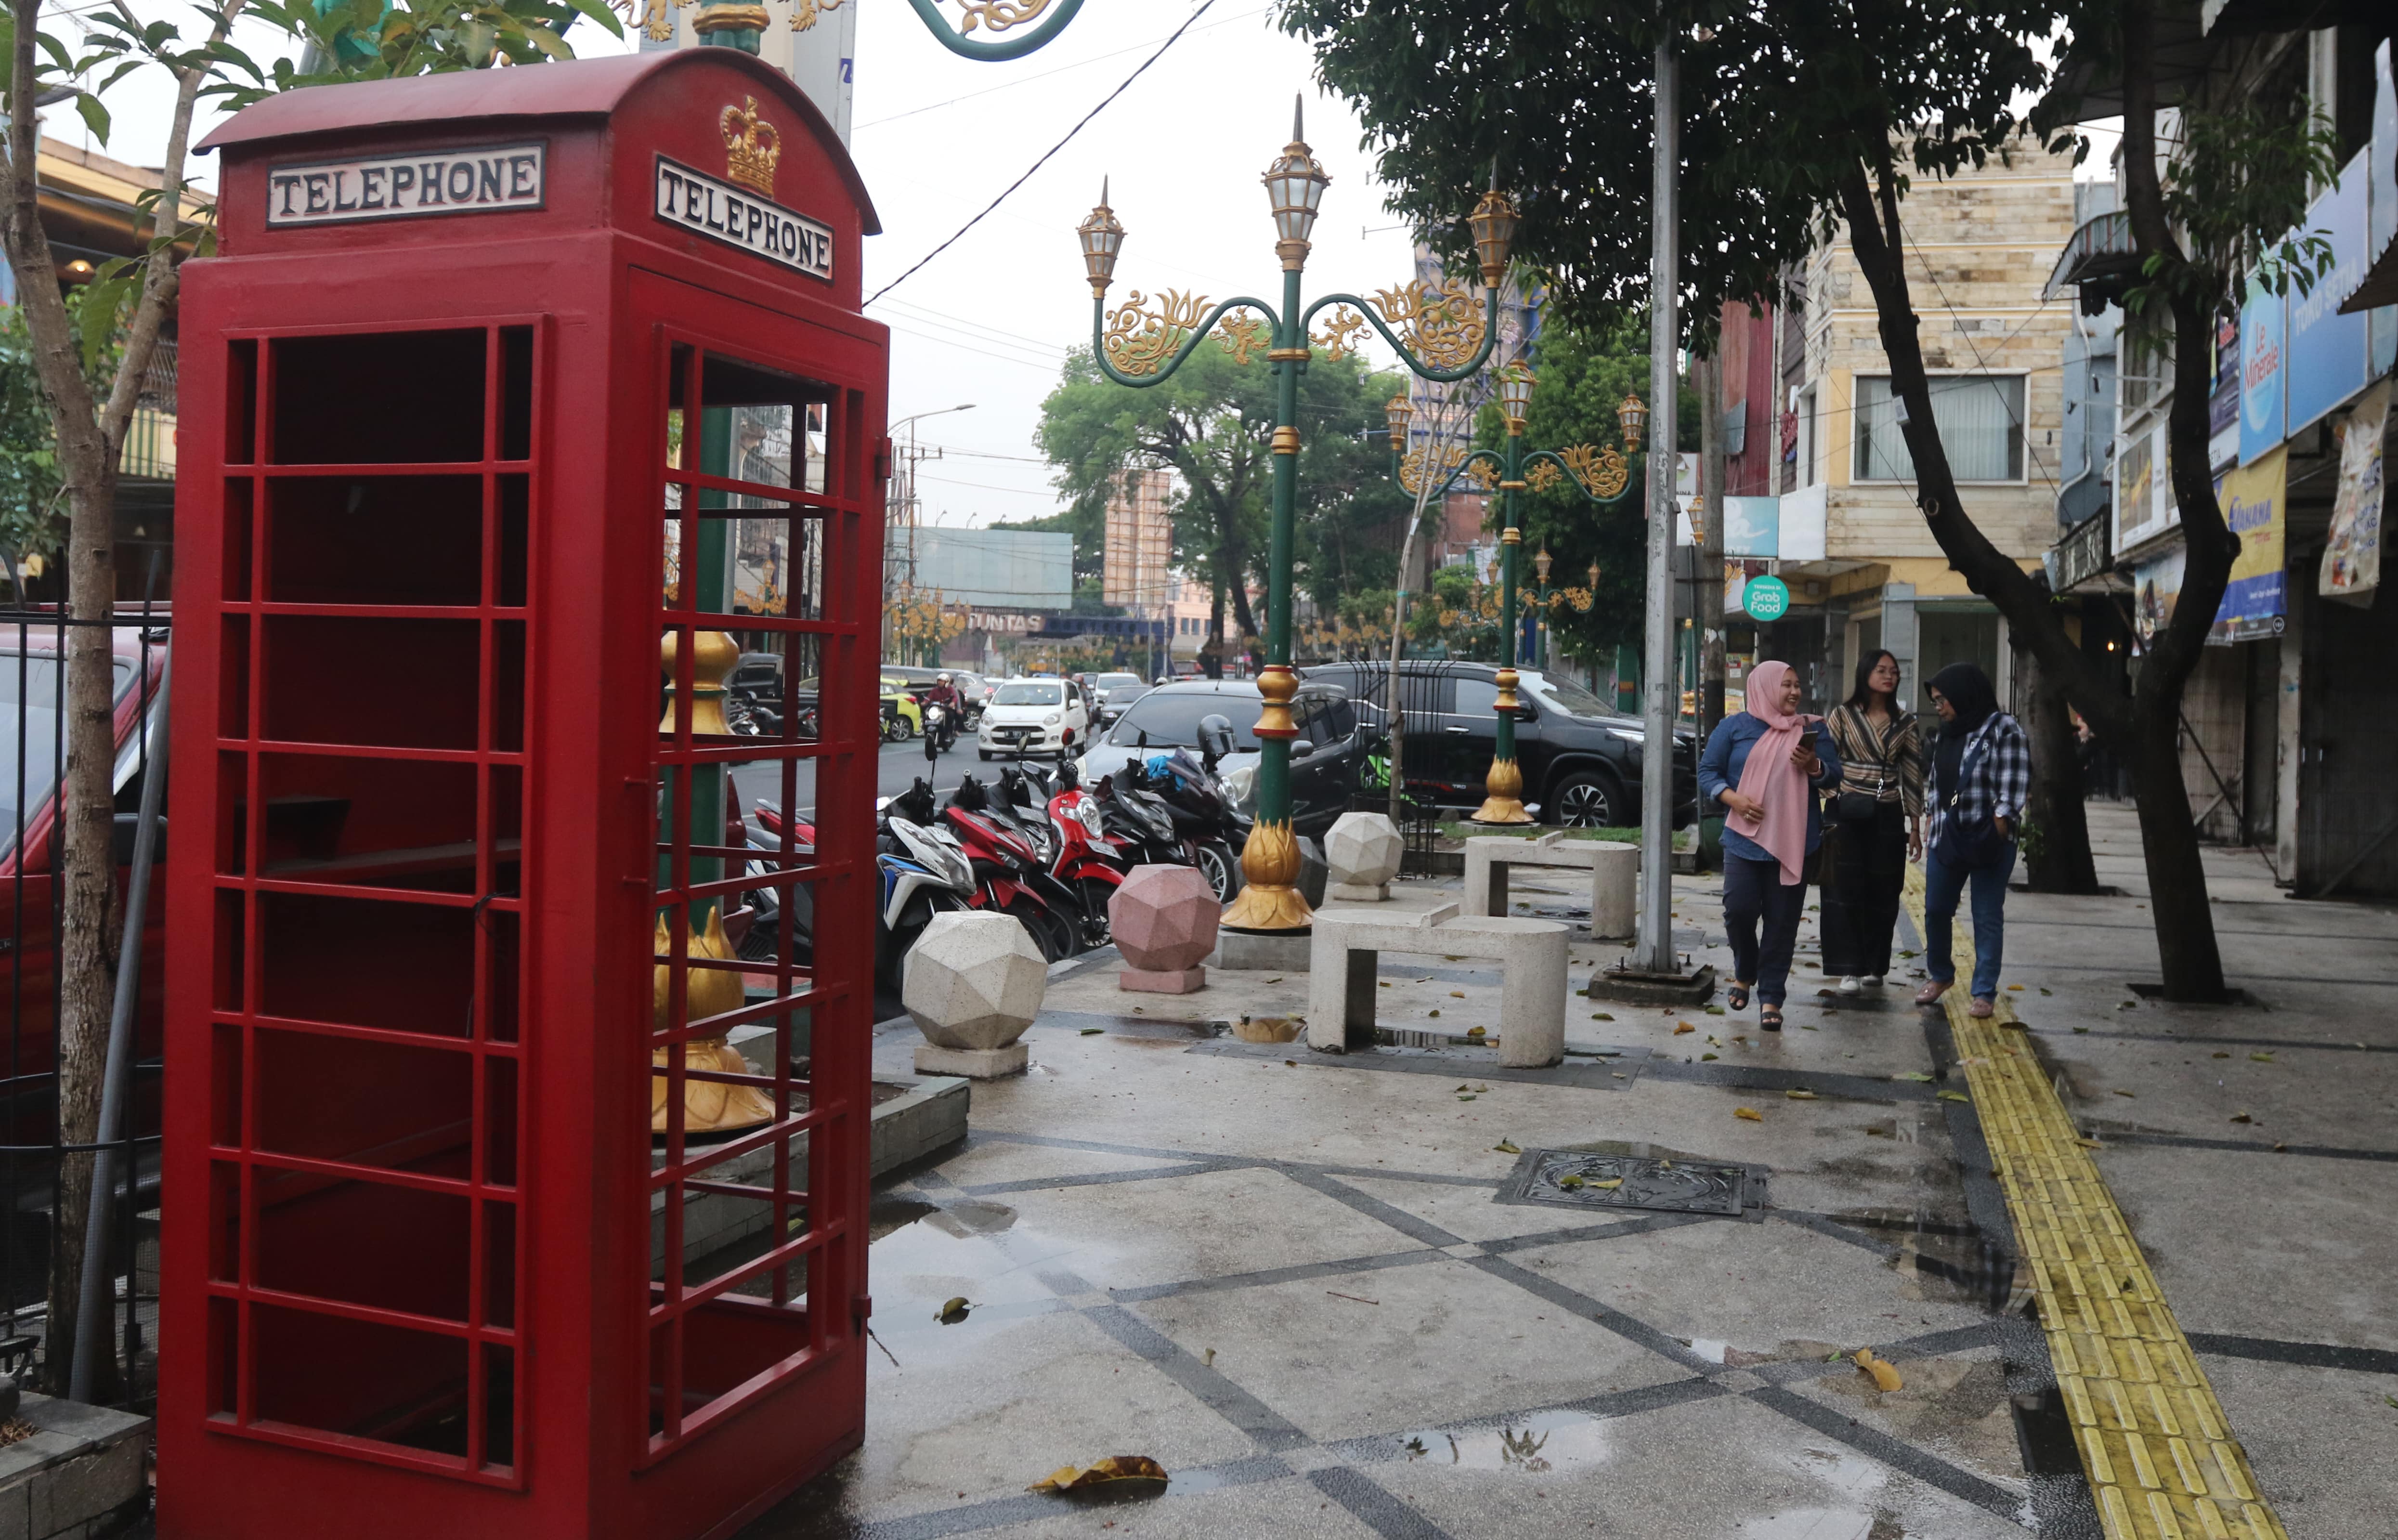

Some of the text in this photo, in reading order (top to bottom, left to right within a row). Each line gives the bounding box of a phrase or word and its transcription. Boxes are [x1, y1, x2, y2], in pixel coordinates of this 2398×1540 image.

[273, 154, 537, 216] TELEPHONE
[662, 169, 830, 271] TELEPHONE
[2295, 289, 2322, 336] TOKO
[2255, 321, 2266, 355] Le
[2244, 339, 2278, 393] Minerale
[1751, 602, 1780, 613] Food
[1752, 591, 1780, 601] Grab
